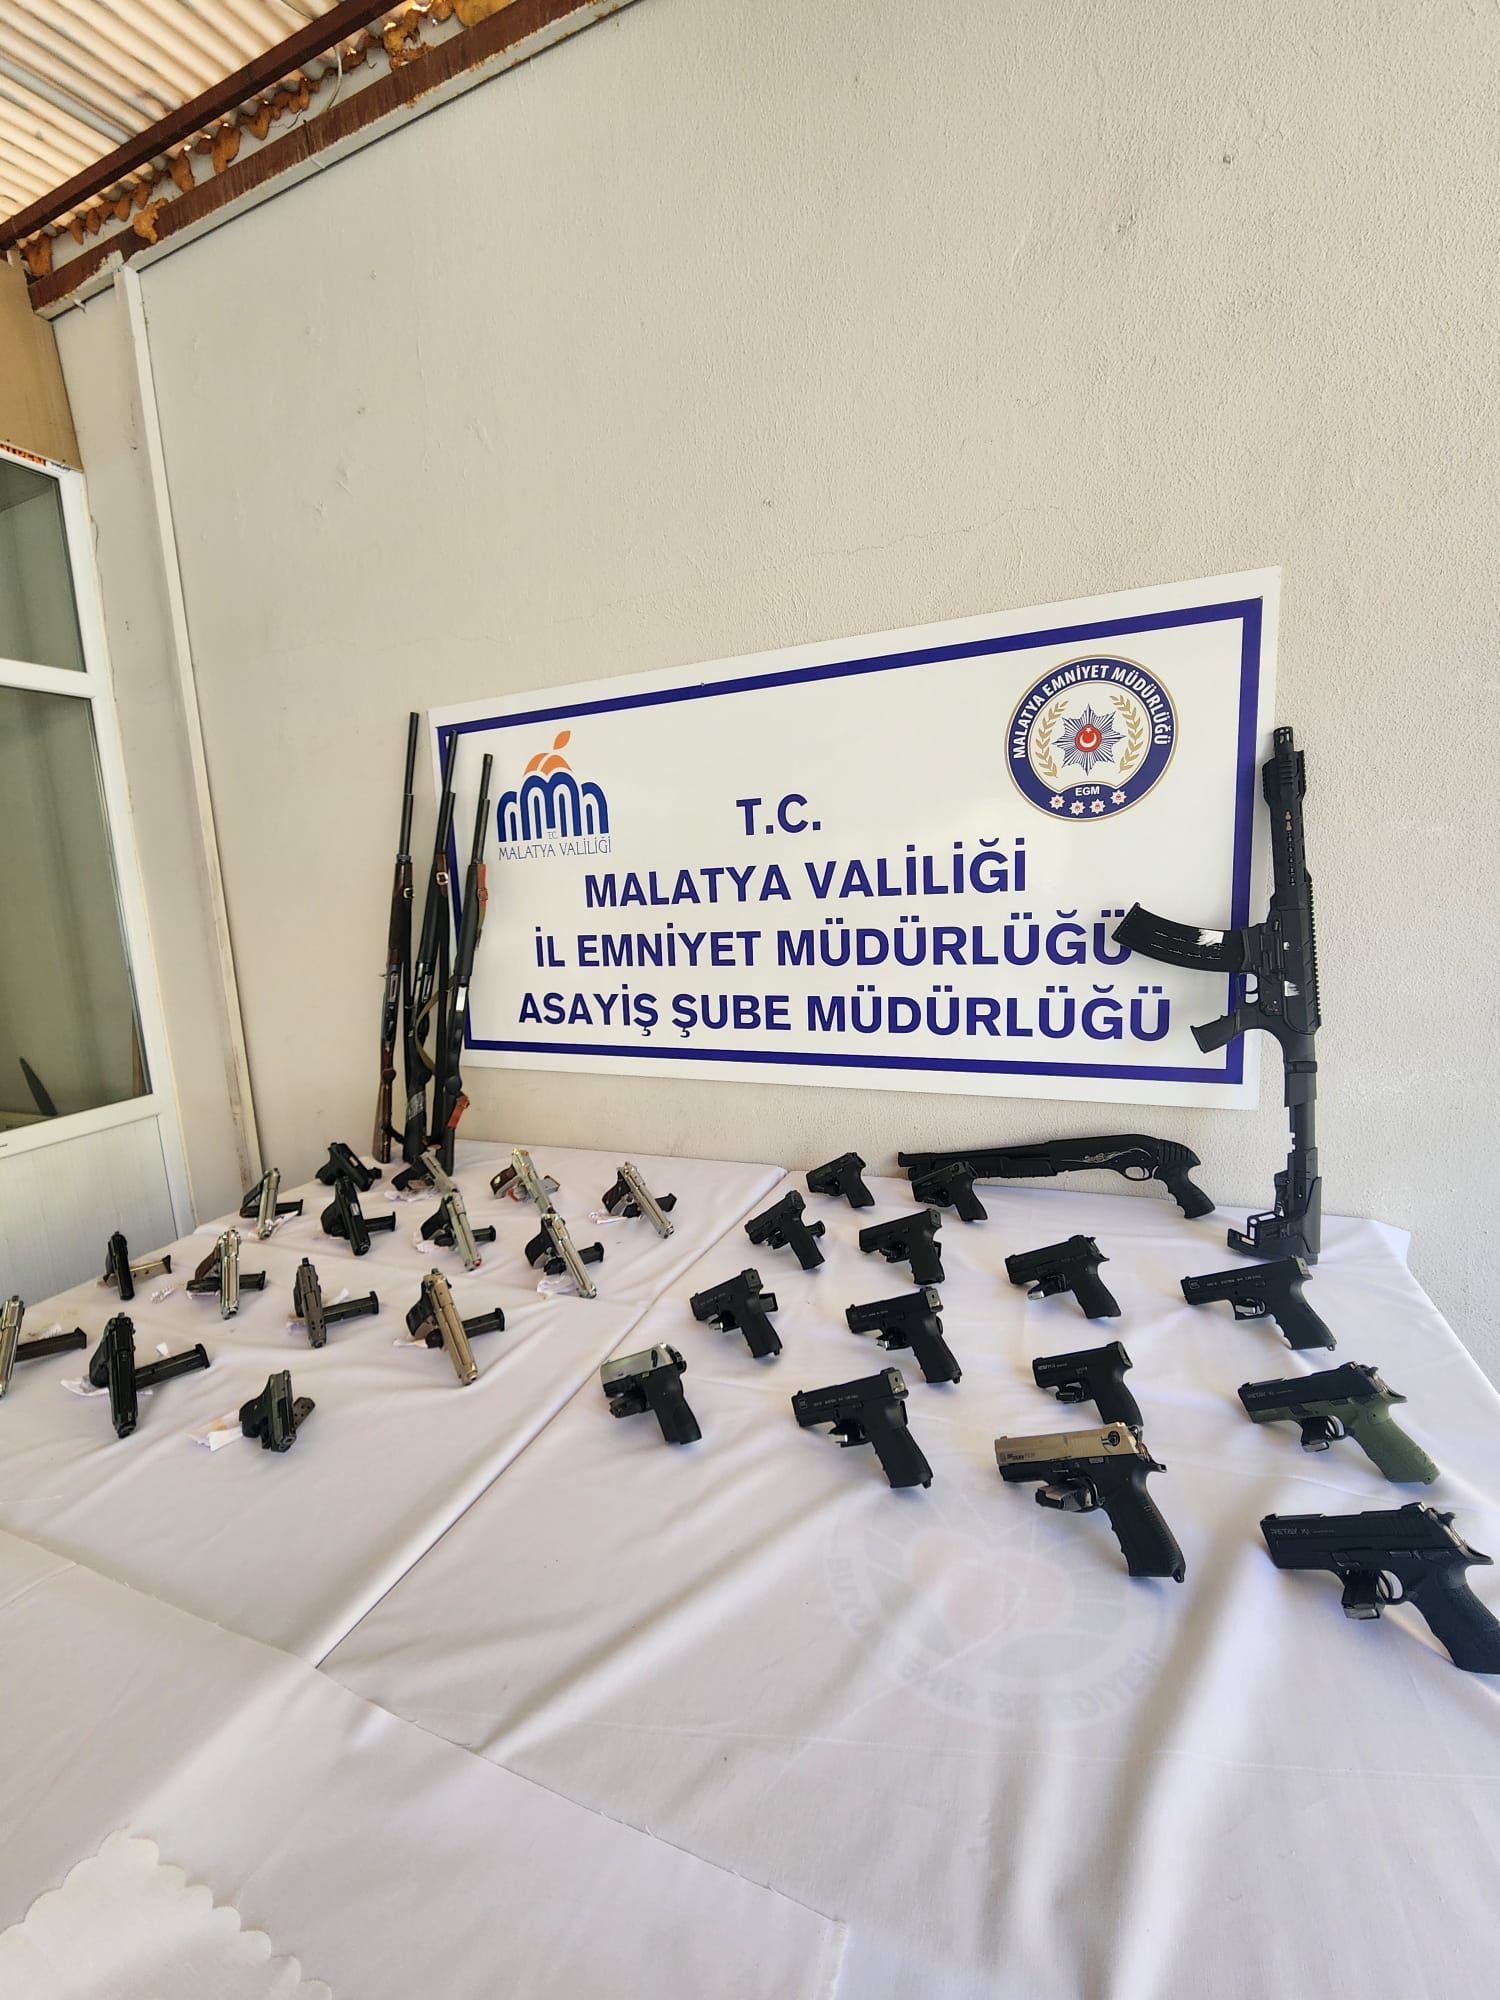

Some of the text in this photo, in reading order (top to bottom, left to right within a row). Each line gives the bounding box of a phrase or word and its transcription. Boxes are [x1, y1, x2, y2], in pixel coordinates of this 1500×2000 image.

[1013, 664, 1173, 759] MALATYA EMNİYET MÜDÜRLÜĞÜ
[736, 793, 821, 836] T.C.
[1075, 786, 1100, 797] EGM
[499, 835, 612, 861] MALATYA VALİLİĞİ
[586, 837, 1026, 907] MALATYA VALİLİĞİ
[535, 909, 1132, 967] İL EMNİYET MÜDÜRLÜĞÜ
[519, 984, 1170, 1041] ASAYİŞ ŞUBE MÜDÜRLÜĞÜ
